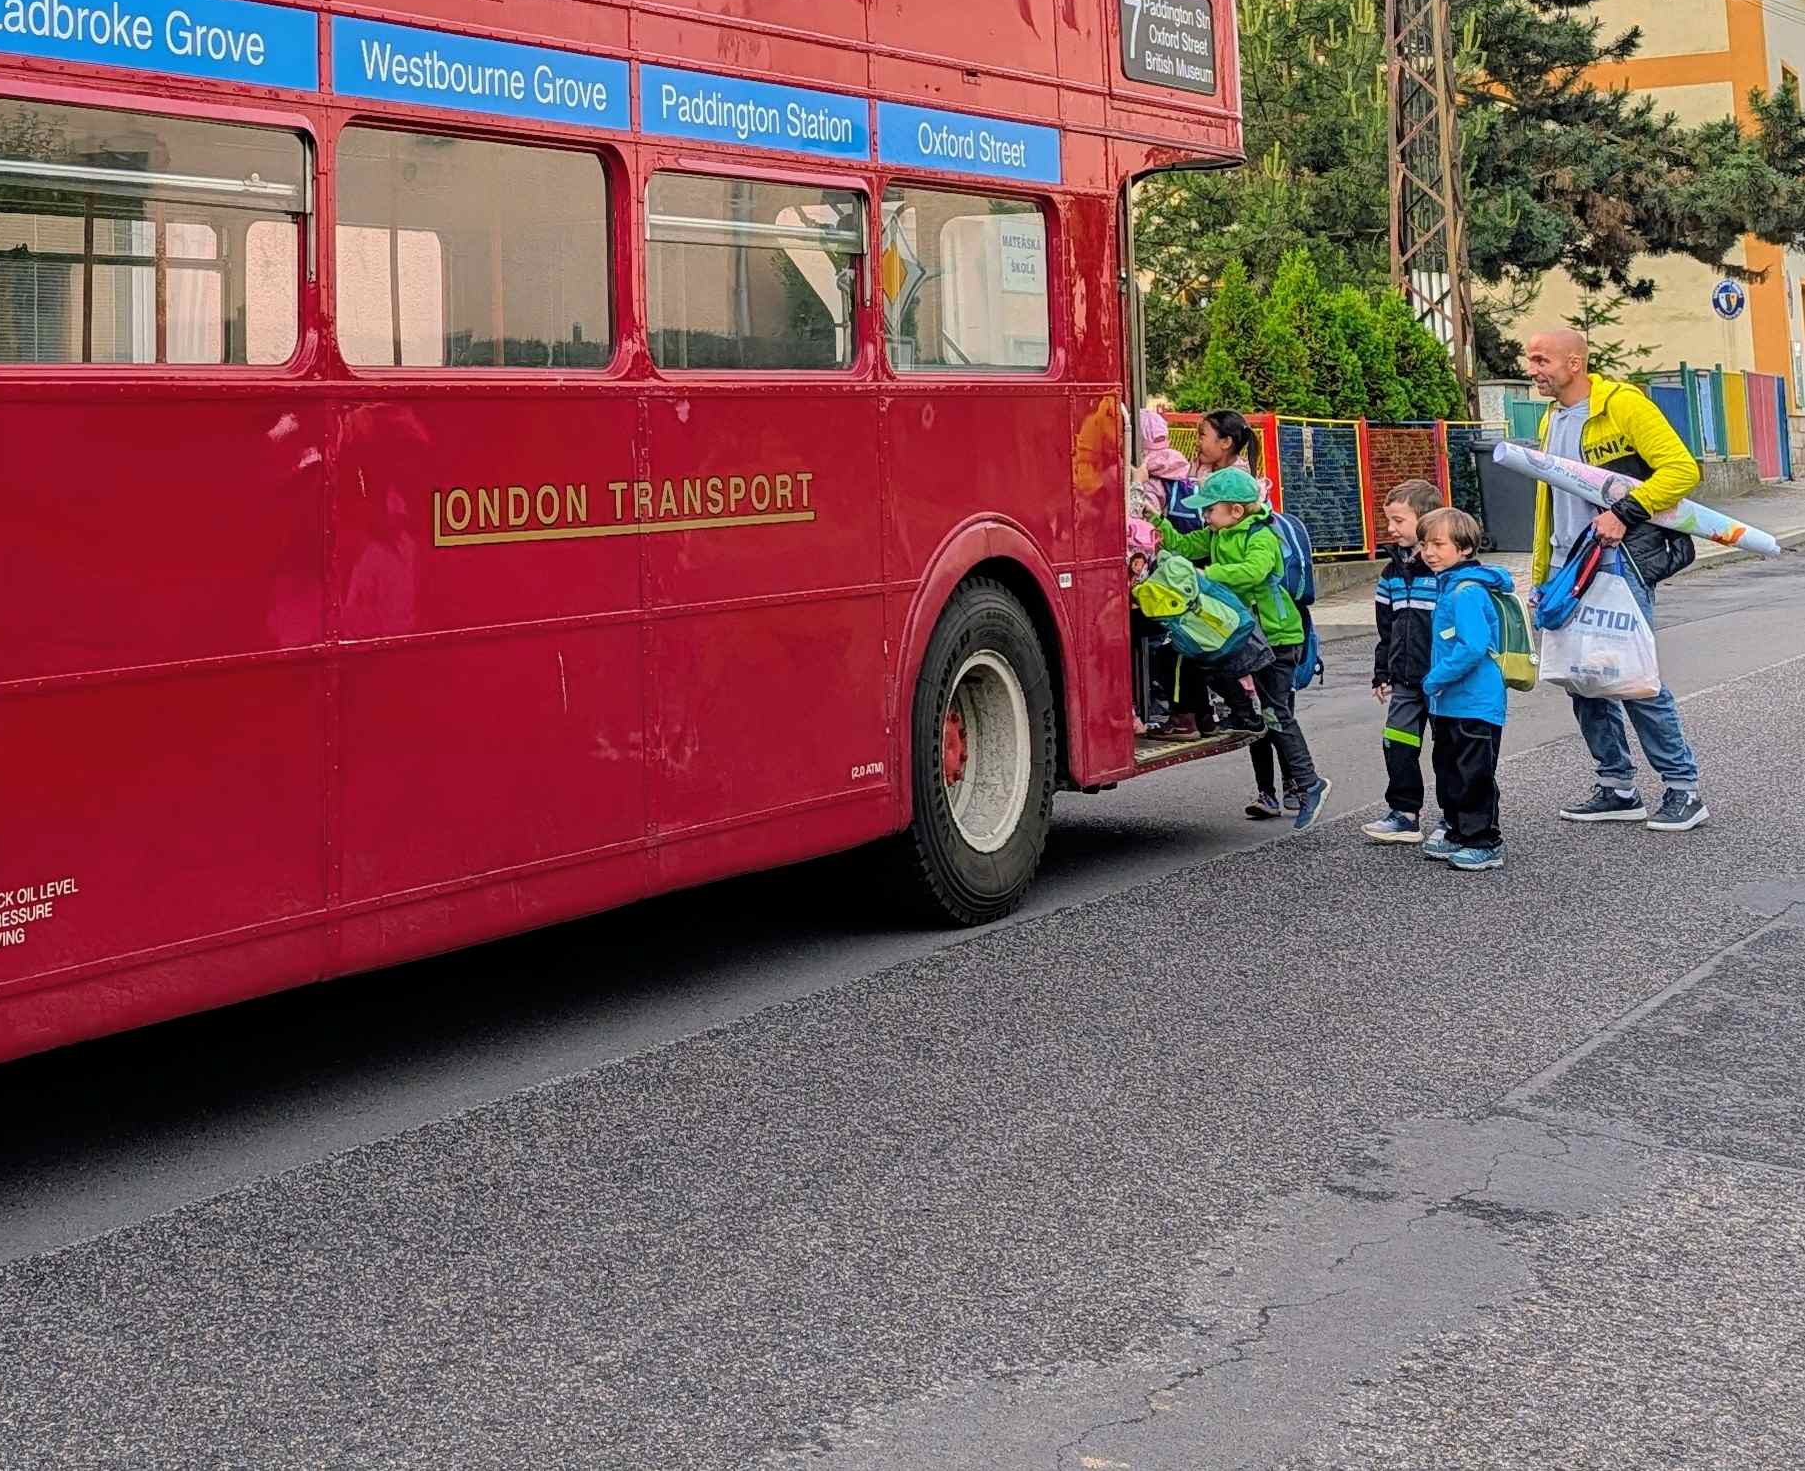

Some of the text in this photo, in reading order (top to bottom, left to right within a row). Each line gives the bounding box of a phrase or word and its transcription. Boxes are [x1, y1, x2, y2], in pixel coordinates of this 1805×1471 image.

[165, 10, 266, 66] Grove
[1149, 24, 1209, 57] Oxford Street
[1195, 9, 1211, 31] Stn
[360, 39, 607, 112] Westbourne Grove
[1145, 50, 1214, 84] British Museum
[662, 84, 853, 144] Paddington Station
[918, 122, 1027, 168] Oxford Street
[434, 472, 814, 546] LONDON TRANSPORT
[17, 886, 39, 904] OIL
[40, 878, 79, 899] LEVEL
